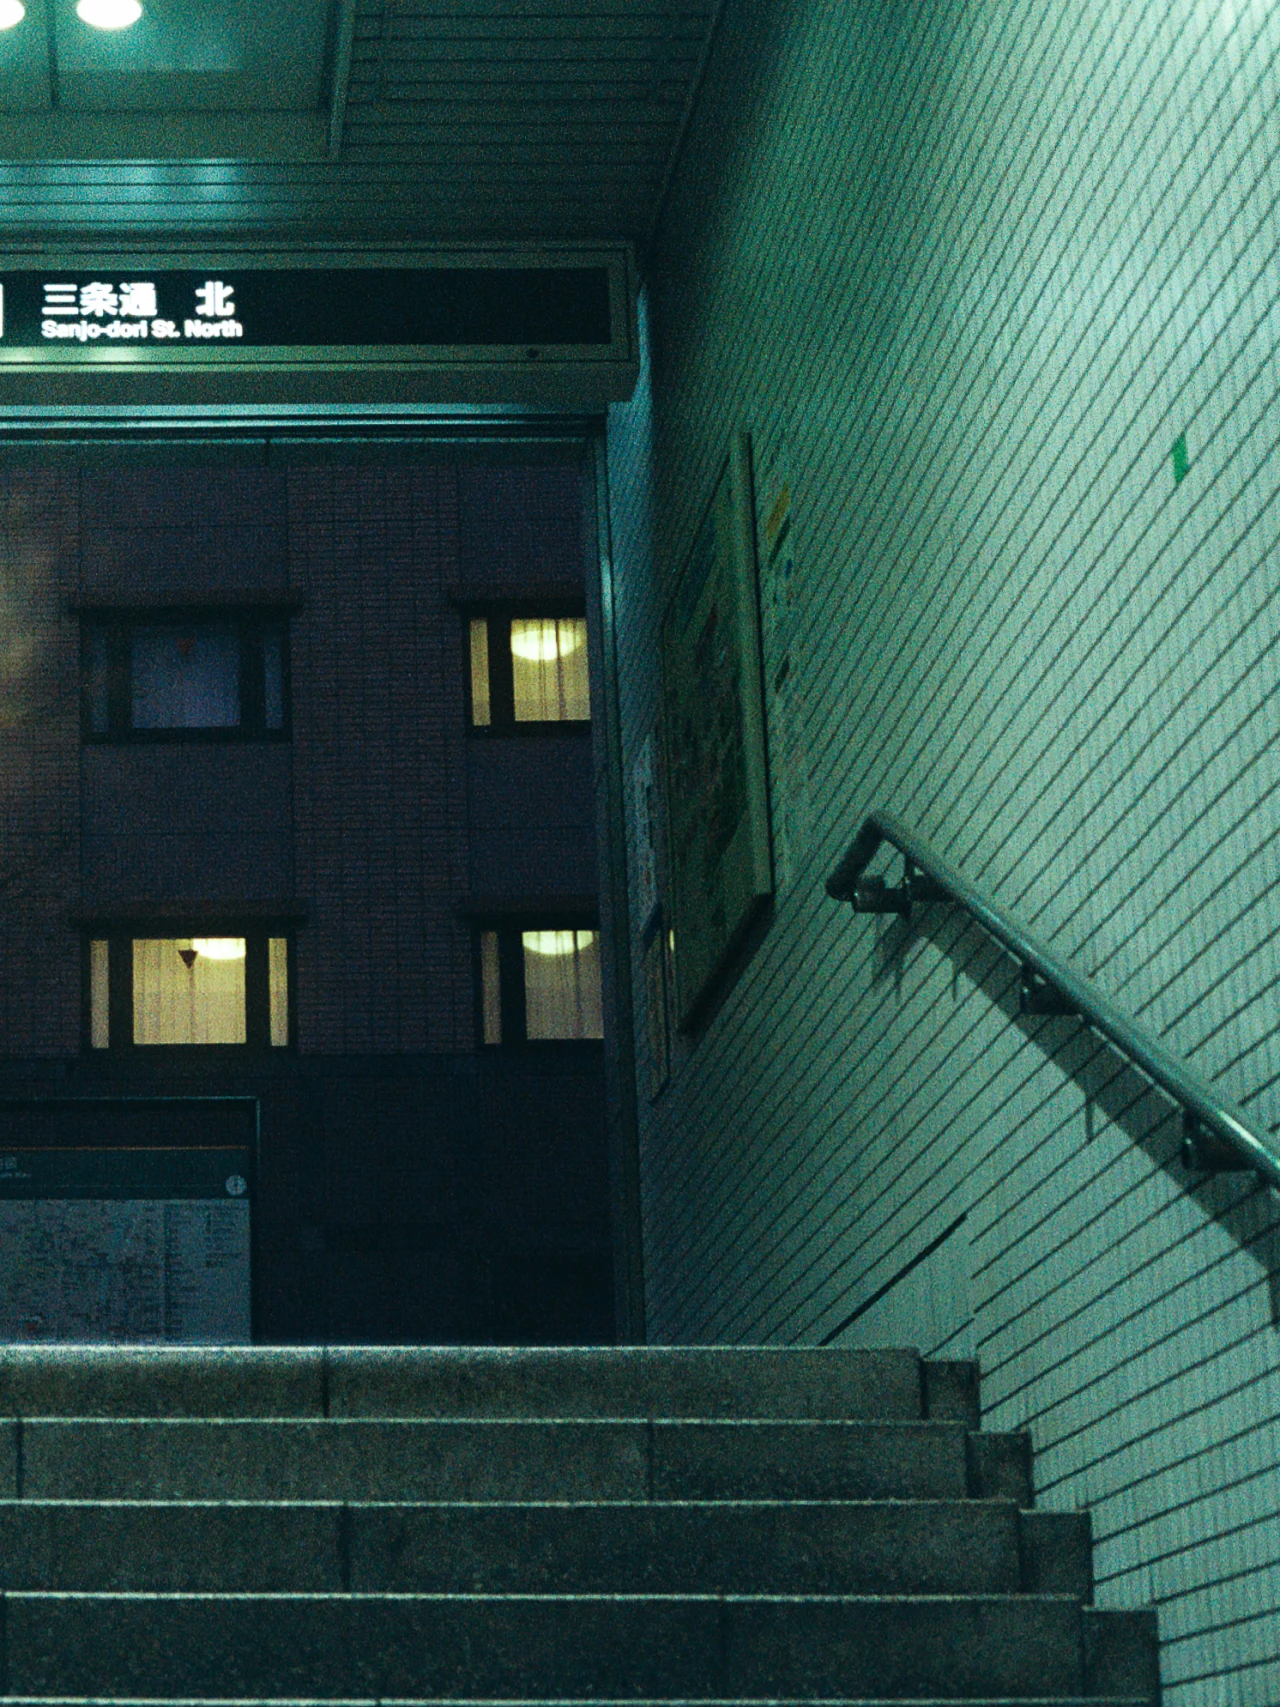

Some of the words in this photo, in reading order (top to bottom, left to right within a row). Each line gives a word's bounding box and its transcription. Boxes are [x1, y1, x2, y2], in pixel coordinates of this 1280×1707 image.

[42, 281, 158, 317] 三条通
[195, 281, 235, 316] 北
[41, 320, 148, 341] Sanjo-dori
[151, 320, 181, 338] St.
[184, 320, 243, 338] North
